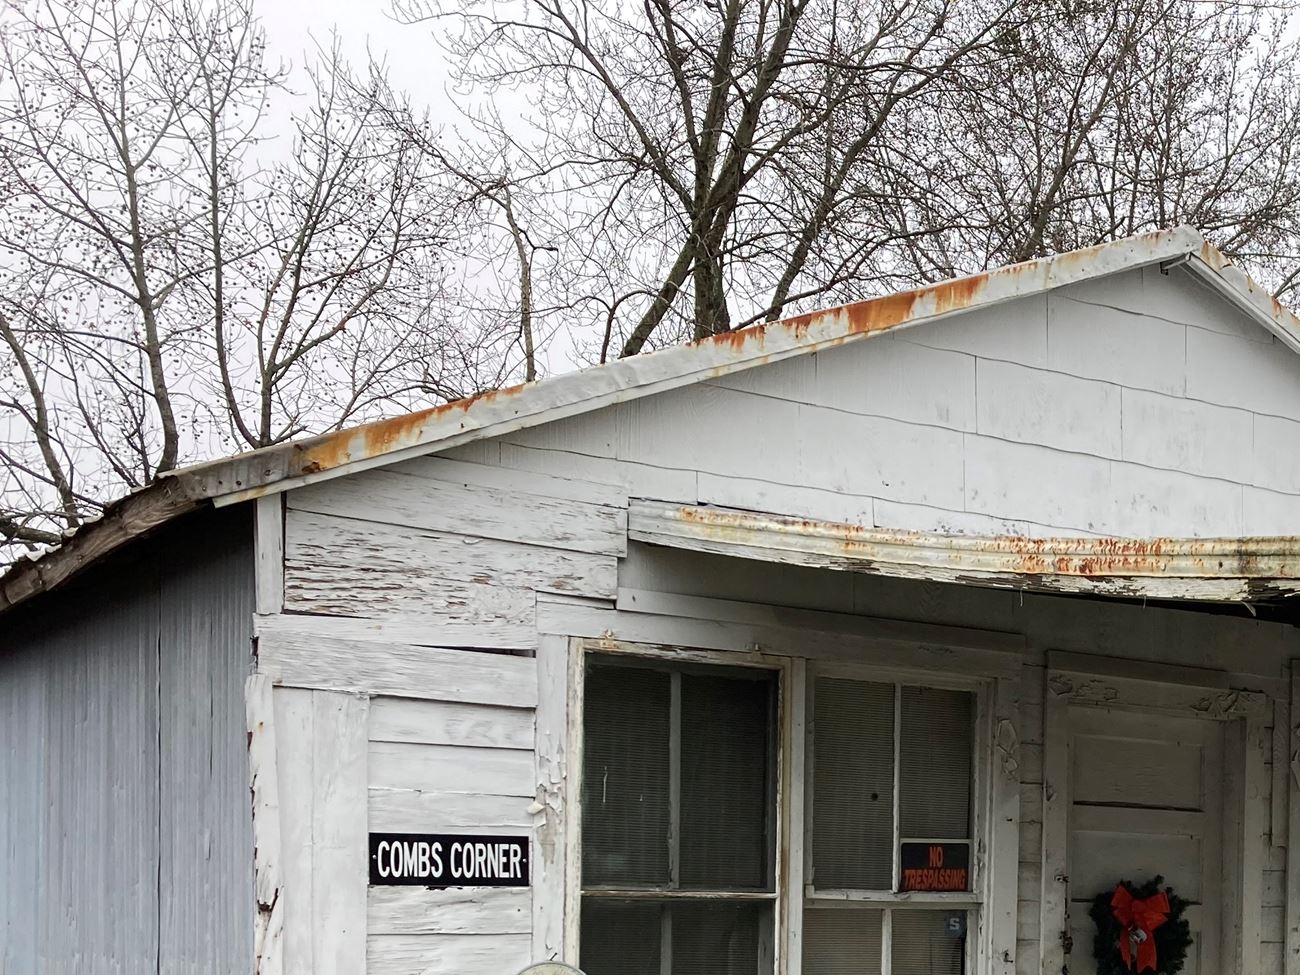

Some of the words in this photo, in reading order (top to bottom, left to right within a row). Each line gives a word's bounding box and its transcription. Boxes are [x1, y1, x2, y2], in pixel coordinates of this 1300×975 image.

[377, 840, 444, 878] COMBS
[450, 842, 522, 879] CORNER
[929, 846, 944, 868] NO
[904, 869, 966, 889] TRESPASSING
